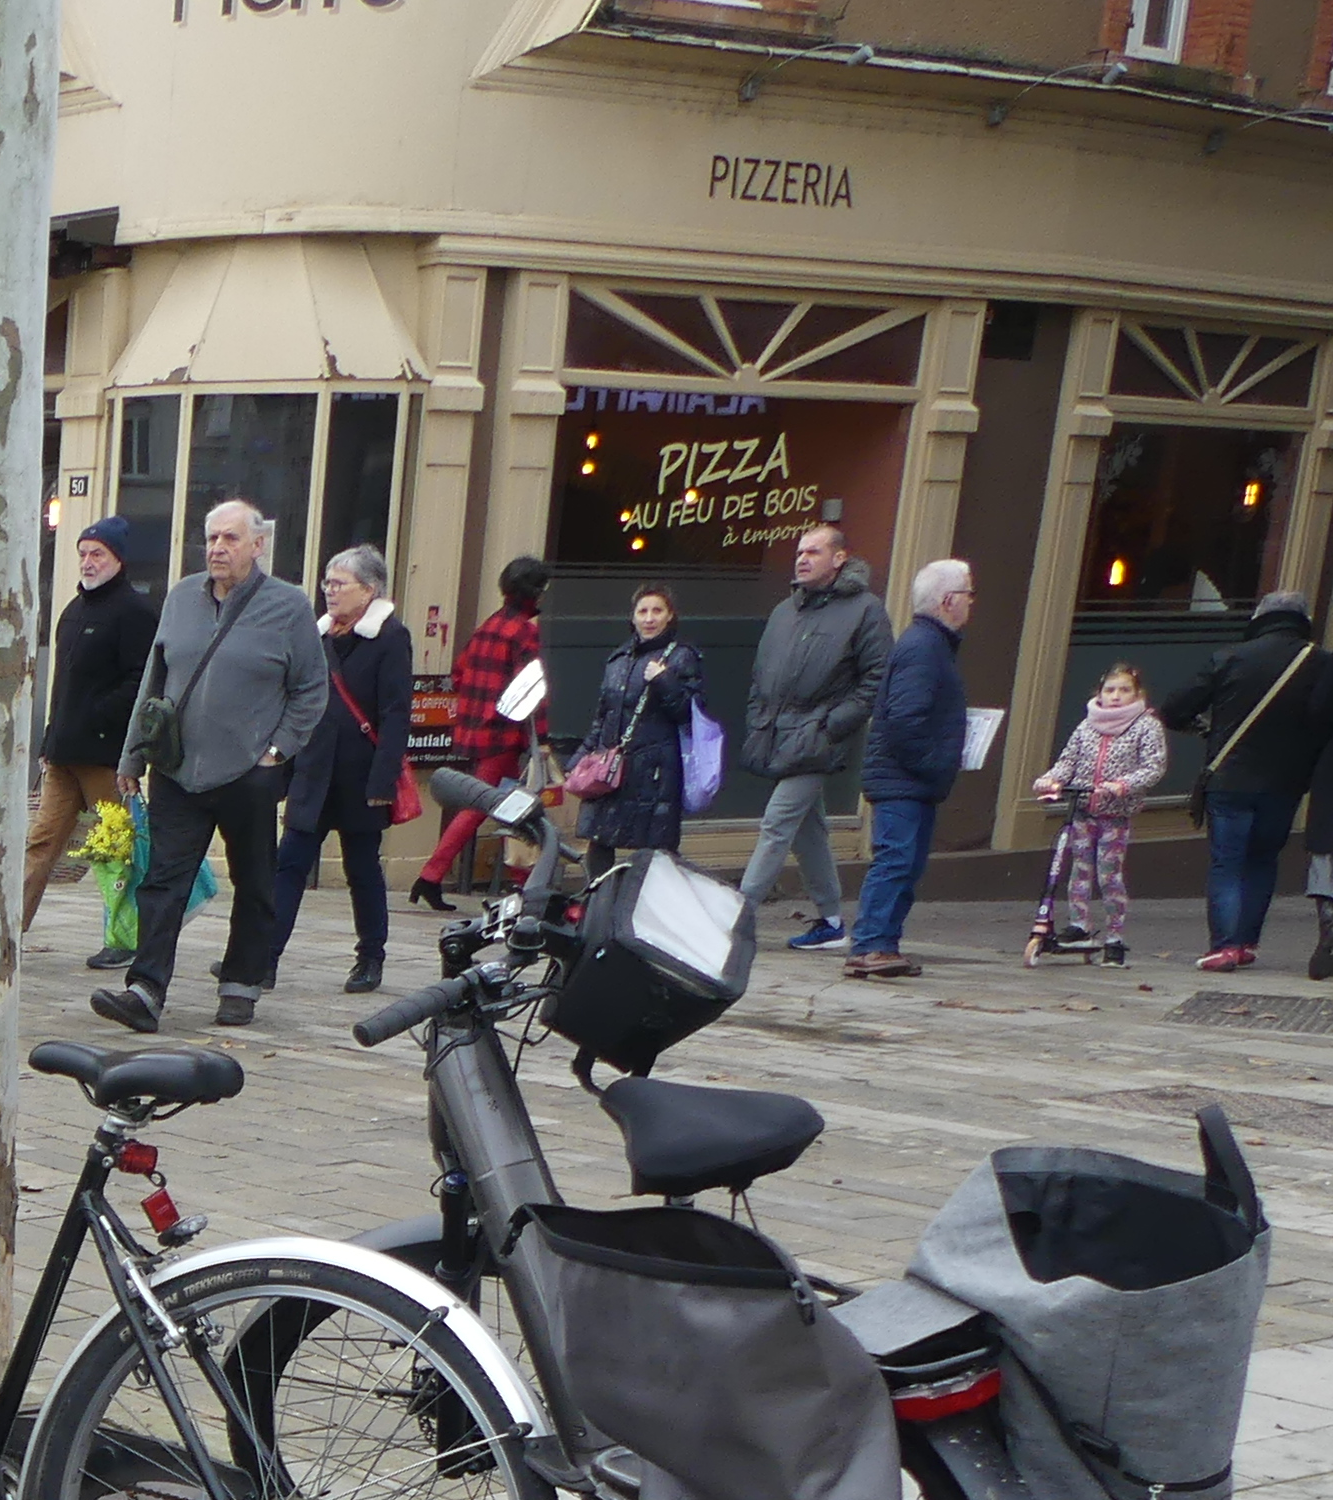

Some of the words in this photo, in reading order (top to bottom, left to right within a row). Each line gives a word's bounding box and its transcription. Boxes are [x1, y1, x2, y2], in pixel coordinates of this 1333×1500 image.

[709, 155, 854, 208] PIZZERIA
[657, 431, 791, 496] PIZZA
[71, 479, 85, 495] 50
[622, 502, 661, 533] AU
[667, 496, 715, 529] FEU
[722, 490, 759, 520] DE
[763, 484, 820, 517] BOIS
[722, 525, 738, 548] à
[406, 733, 452, 748] batiale
